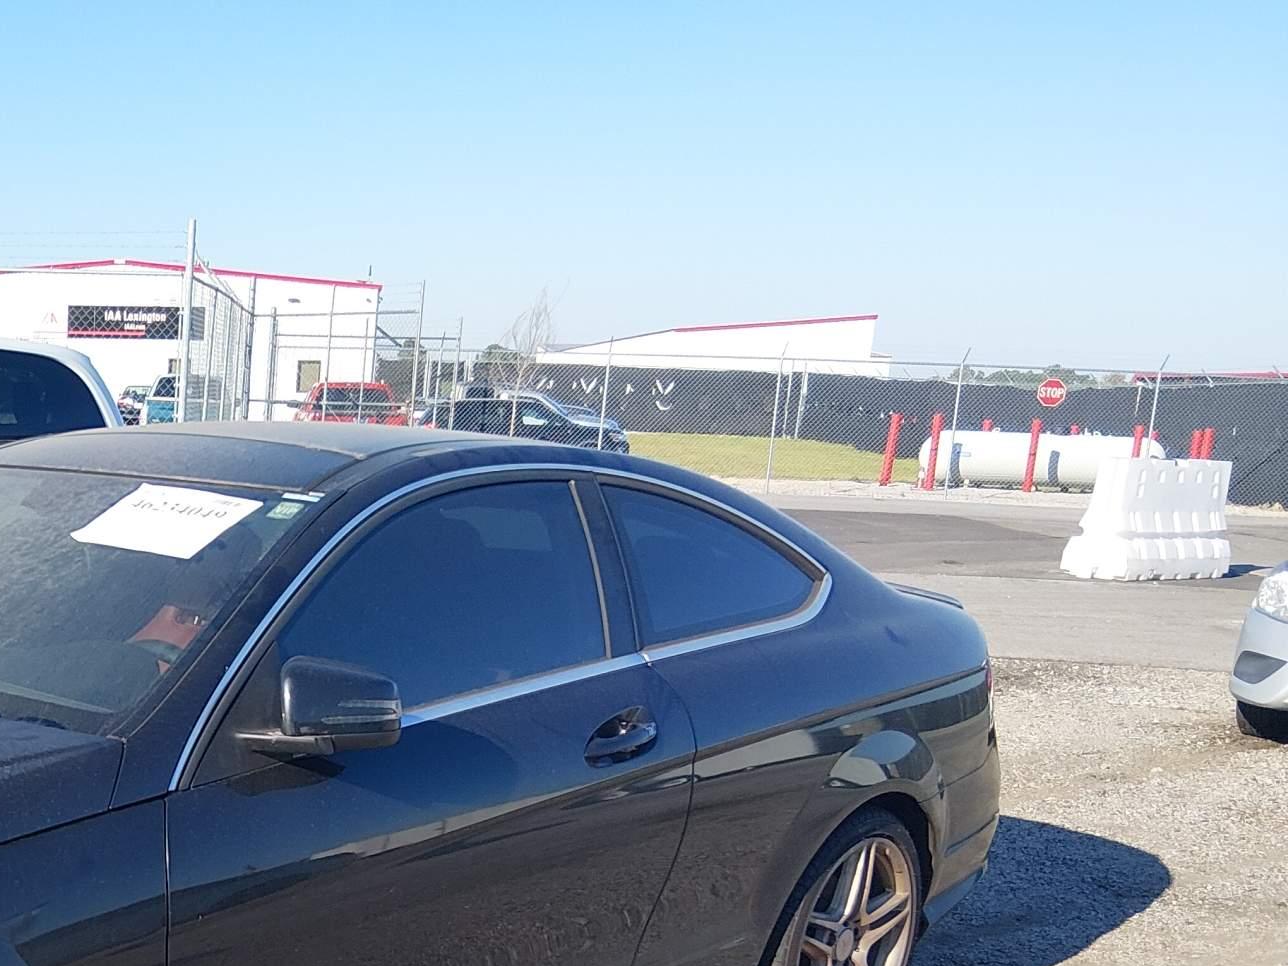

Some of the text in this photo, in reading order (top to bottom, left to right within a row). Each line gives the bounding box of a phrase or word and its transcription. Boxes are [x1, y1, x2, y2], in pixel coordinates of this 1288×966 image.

[104, 310, 167, 324] IAA Lexington
[1039, 387, 1065, 399] STOP
